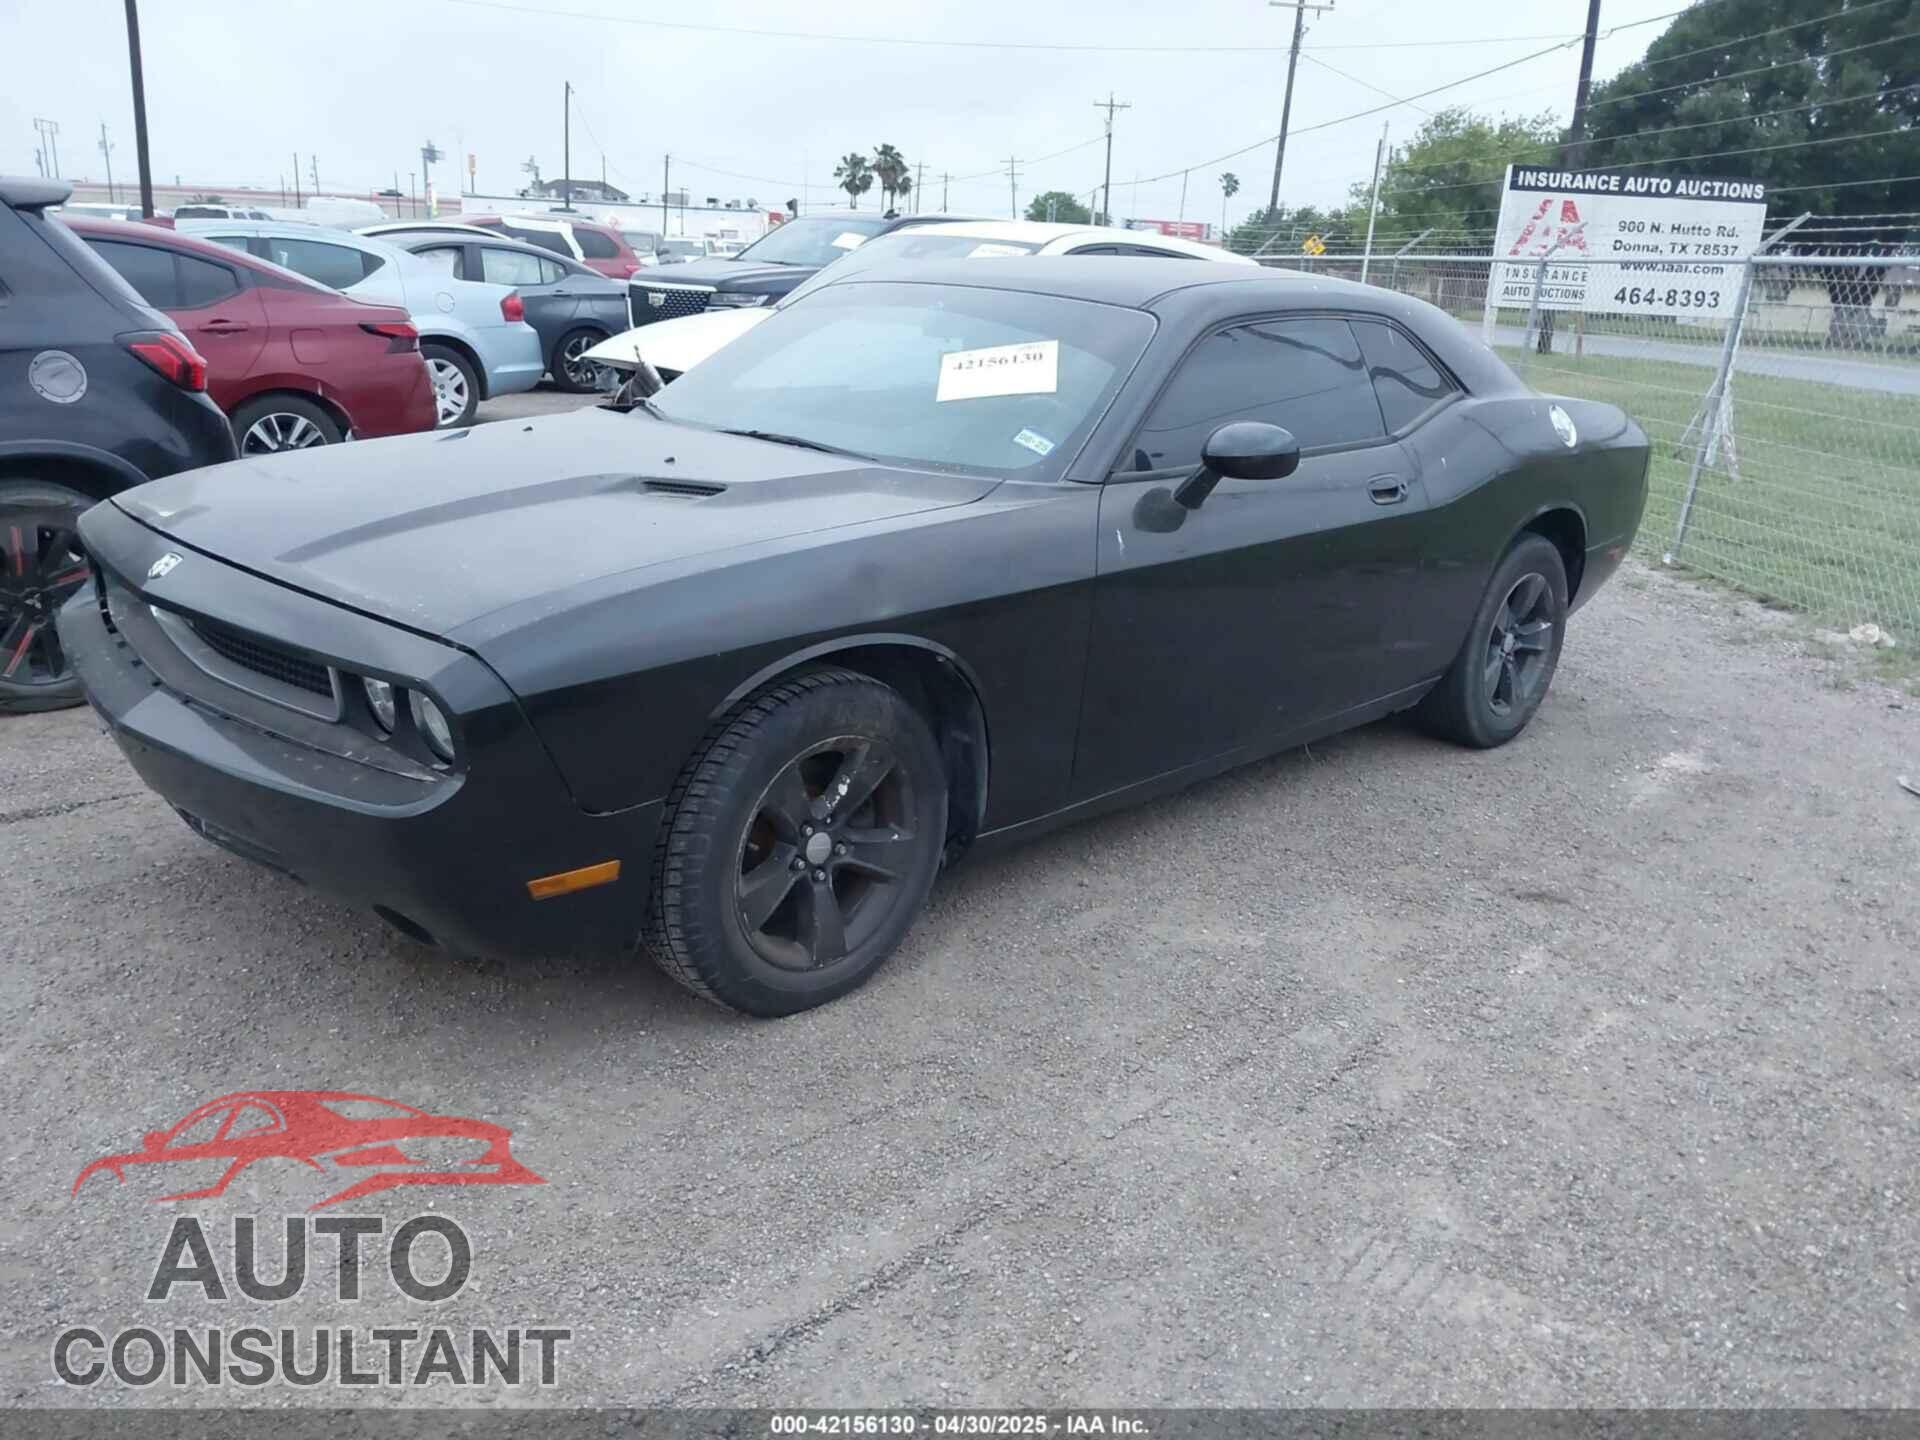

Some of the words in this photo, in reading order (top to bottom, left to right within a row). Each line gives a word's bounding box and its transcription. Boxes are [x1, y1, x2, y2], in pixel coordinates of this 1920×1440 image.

[1517, 170, 1619, 191] INSURANCE
[1624, 176, 1671, 195] AUTO
[1676, 179, 1764, 199] AUCTIONS
[1618, 220, 1645, 233] 900
[1650, 223, 1664, 234] N.
[1671, 224, 1711, 236] Hutto
[1716, 225, 1740, 238] Rd.
[1612, 240, 1663, 254] Donna,
[1669, 242, 1689, 254] TX
[1694, 244, 1738, 257] 78537
[1502, 286, 1530, 297] AUTO
[1533, 287, 1585, 300] UCTIONS
[1614, 286, 1720, 309] 464-8393
